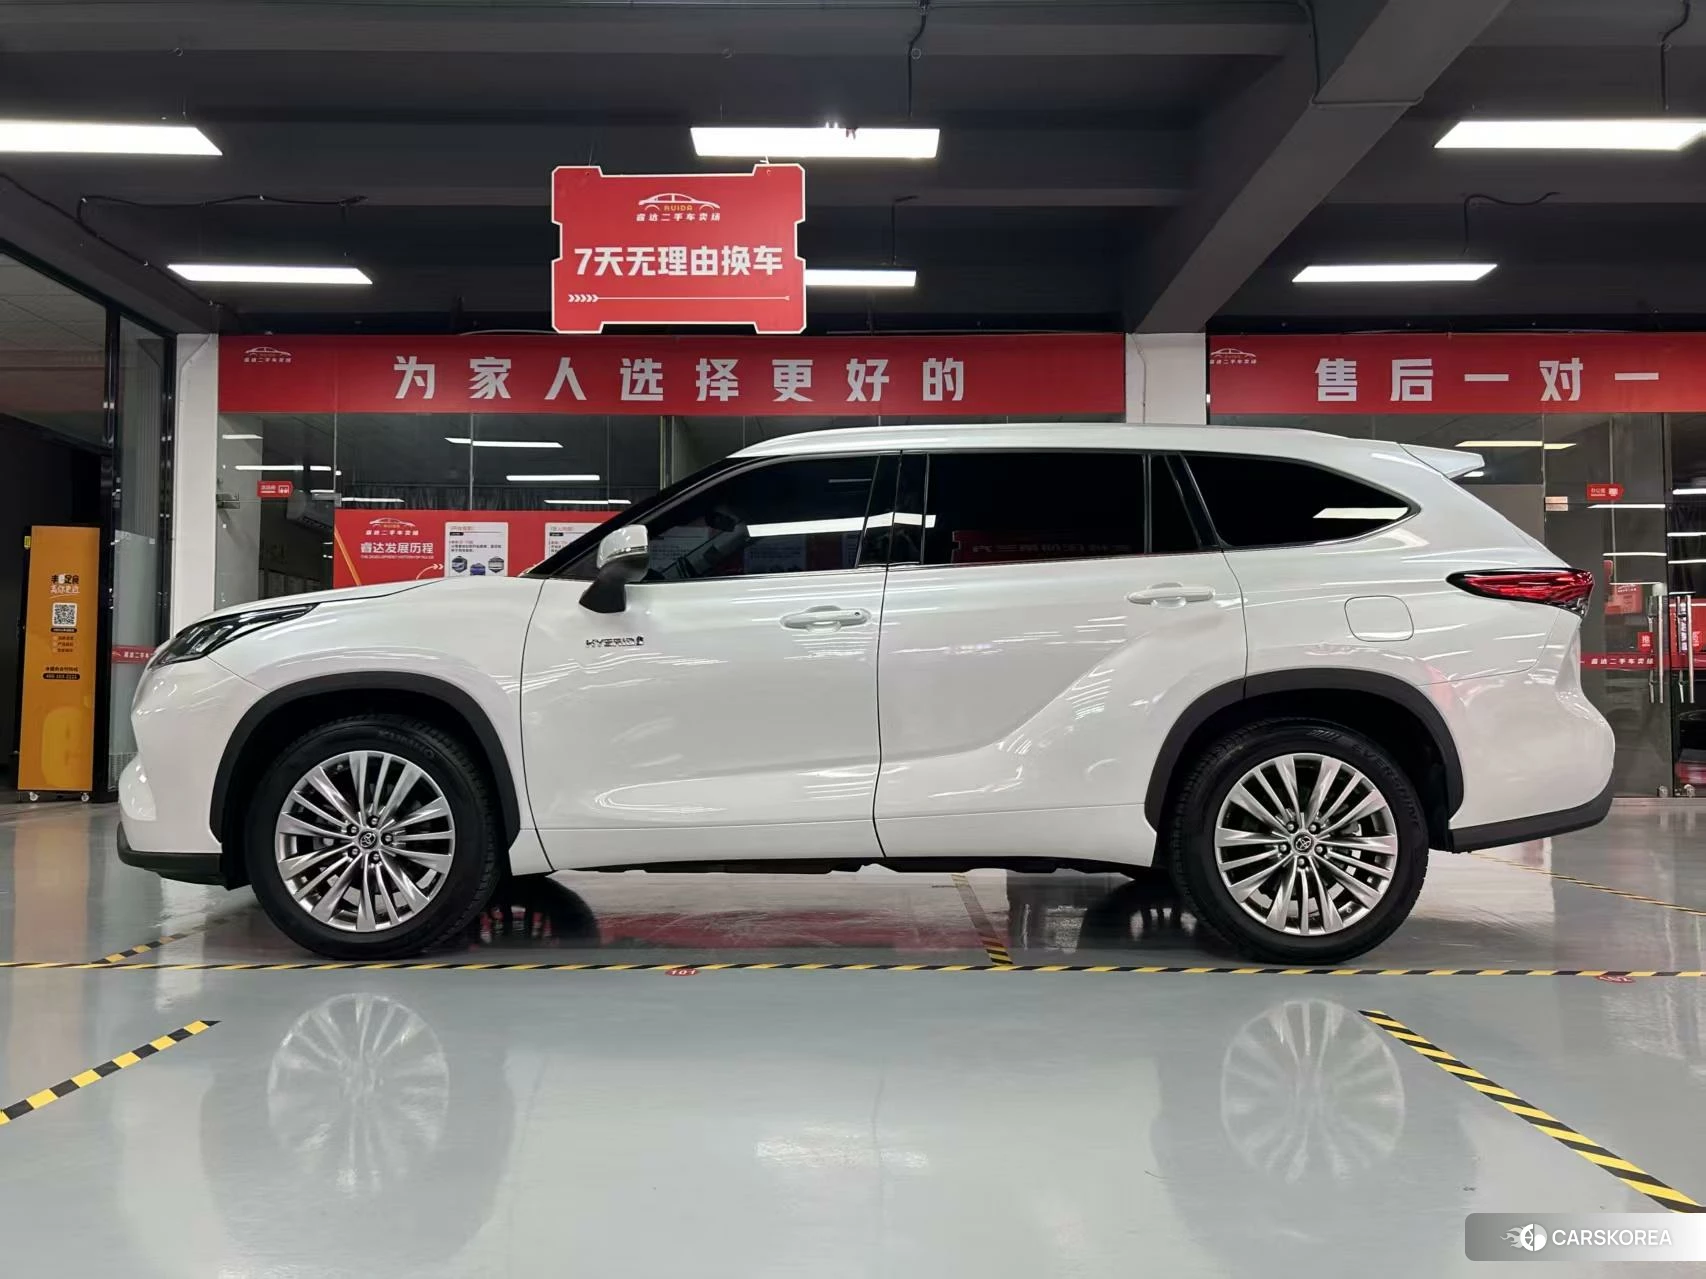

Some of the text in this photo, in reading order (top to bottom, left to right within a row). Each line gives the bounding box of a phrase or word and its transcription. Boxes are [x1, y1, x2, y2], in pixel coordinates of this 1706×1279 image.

[636, 213, 721, 222] 睿达二手车卖场
[663, 204, 693, 212] RUIDA
[574, 245, 783, 277] 7天无理由换车
[393, 355, 965, 402] 为家人选择更好的
[1315, 357, 1660, 402] 售后一对一
[360, 542, 434, 554] 睿达发展历程
